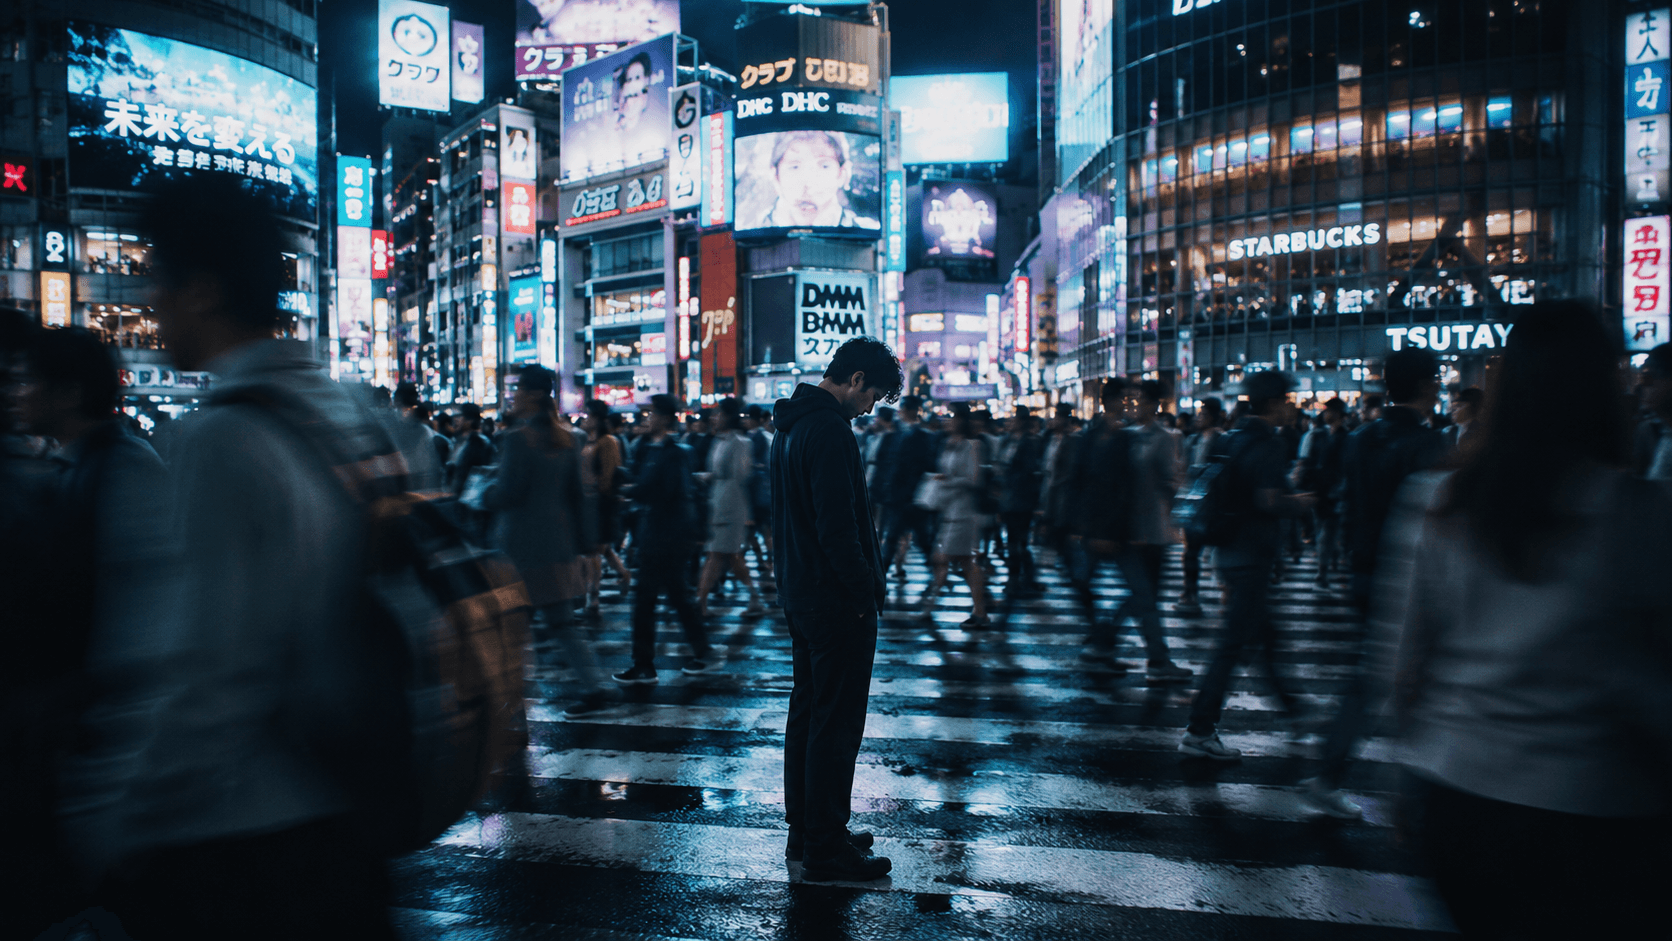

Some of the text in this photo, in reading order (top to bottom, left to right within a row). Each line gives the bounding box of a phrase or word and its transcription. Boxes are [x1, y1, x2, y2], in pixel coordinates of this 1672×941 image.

[737, 97, 773, 119] DHC
[781, 92, 830, 112] DHC
[104, 98, 296, 165] 未来を変える
[1228, 222, 1381, 261] STARBUCKS
[801, 282, 866, 311] DMM
[802, 311, 866, 335] BMM
